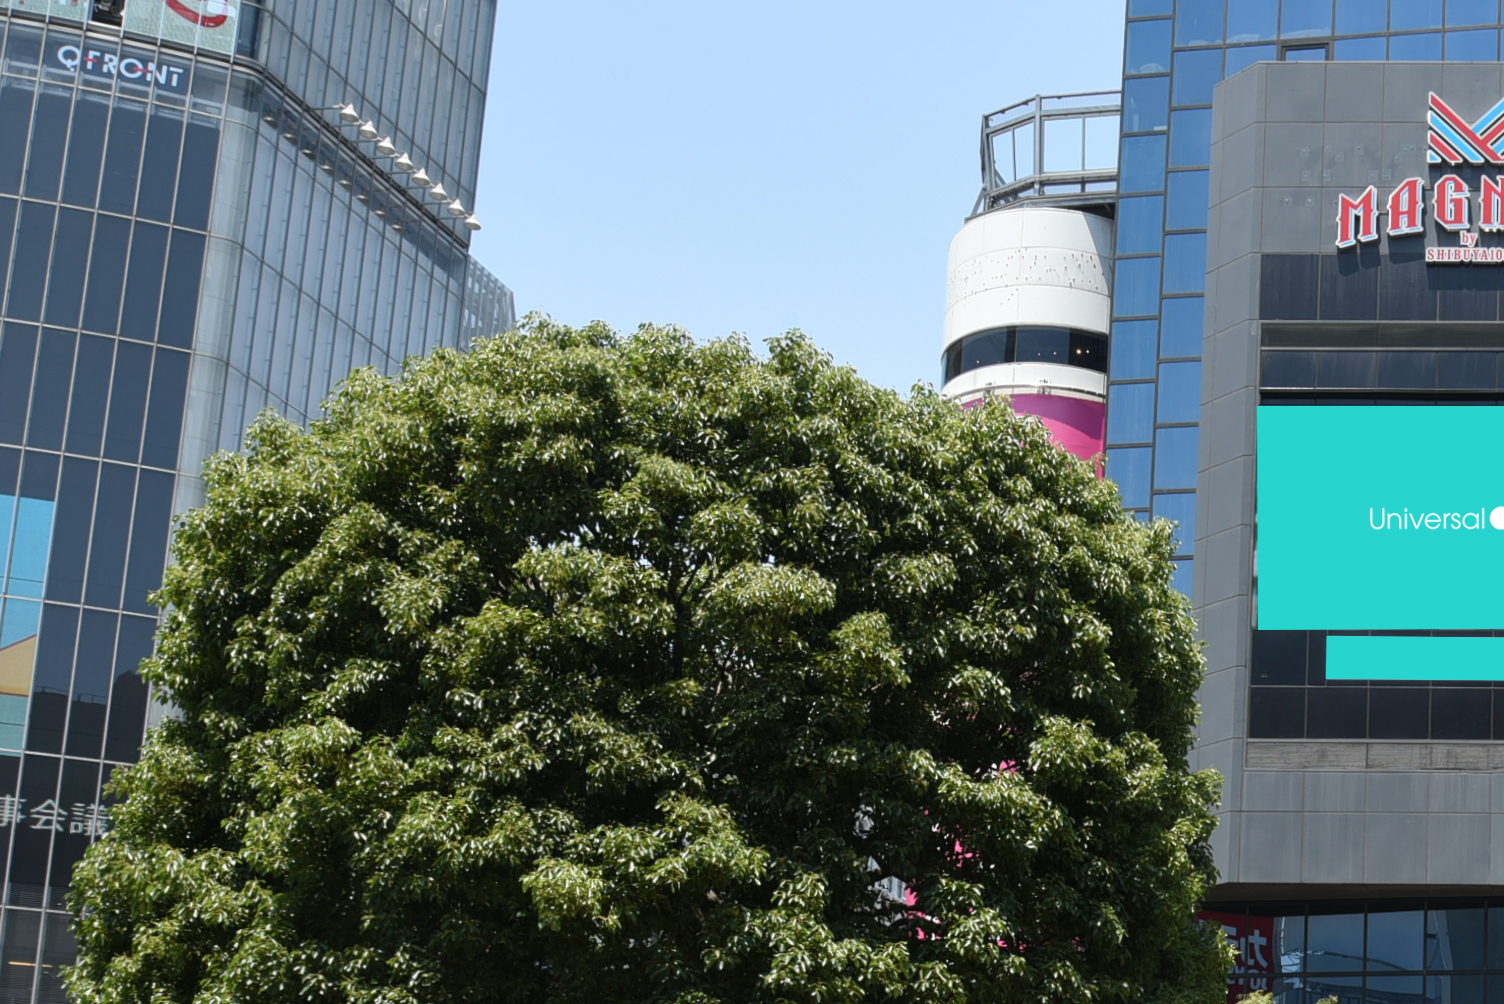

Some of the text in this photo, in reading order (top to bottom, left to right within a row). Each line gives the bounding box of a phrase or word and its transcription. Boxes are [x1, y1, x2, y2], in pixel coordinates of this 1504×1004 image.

[57, 45, 185, 88] QFRONT
[1460, 230, 1478, 247] by
[1369, 507, 1486, 530] Universal
